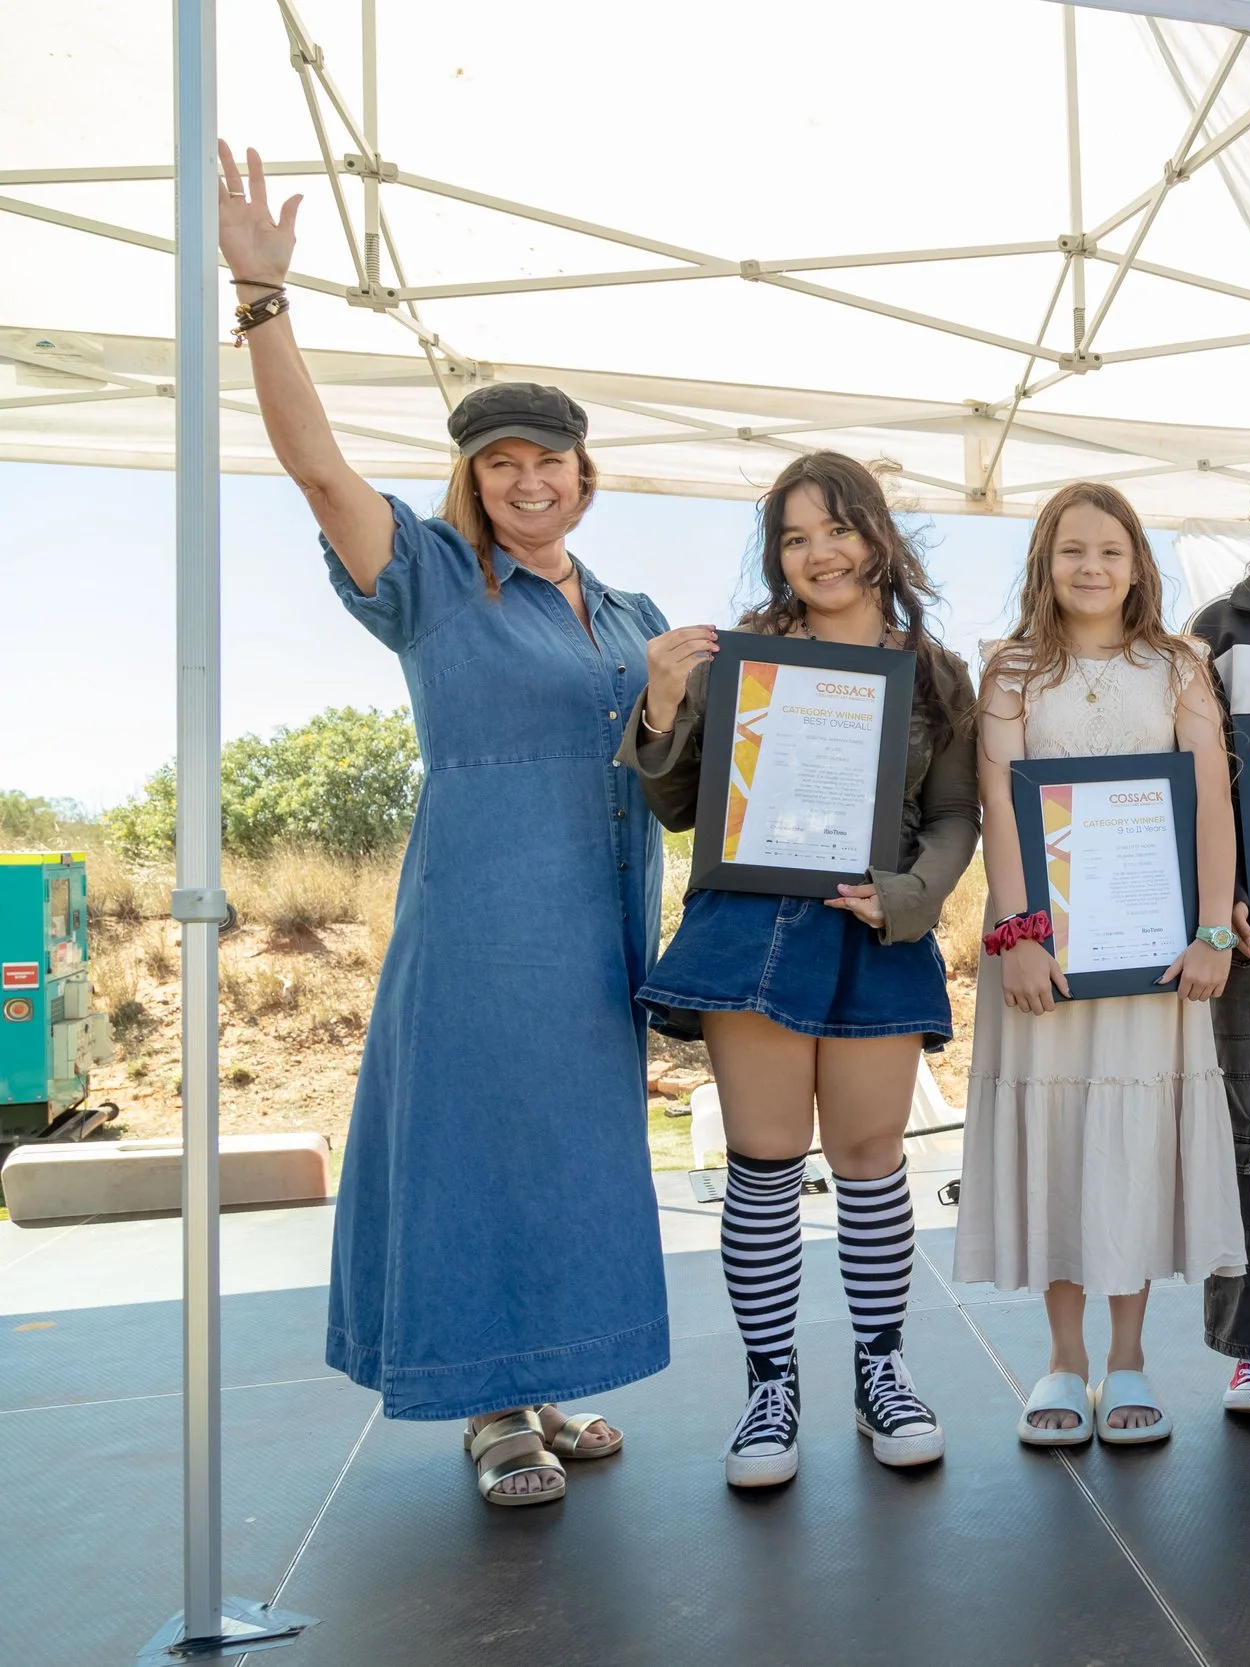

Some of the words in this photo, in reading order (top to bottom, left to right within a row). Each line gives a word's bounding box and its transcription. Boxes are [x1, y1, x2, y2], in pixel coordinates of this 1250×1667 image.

[816, 682, 875, 698] COSSACK
[782, 706, 833, 718] CATEGORY
[835, 711, 872, 721] WINNER
[803, 717, 827, 726] BEST
[830, 720, 872, 731] OVERALL
[1109, 791, 1164, 804] COSSACK
[1083, 819, 1128, 828] CATEGORY
[1131, 816, 1165, 824] WINNER
